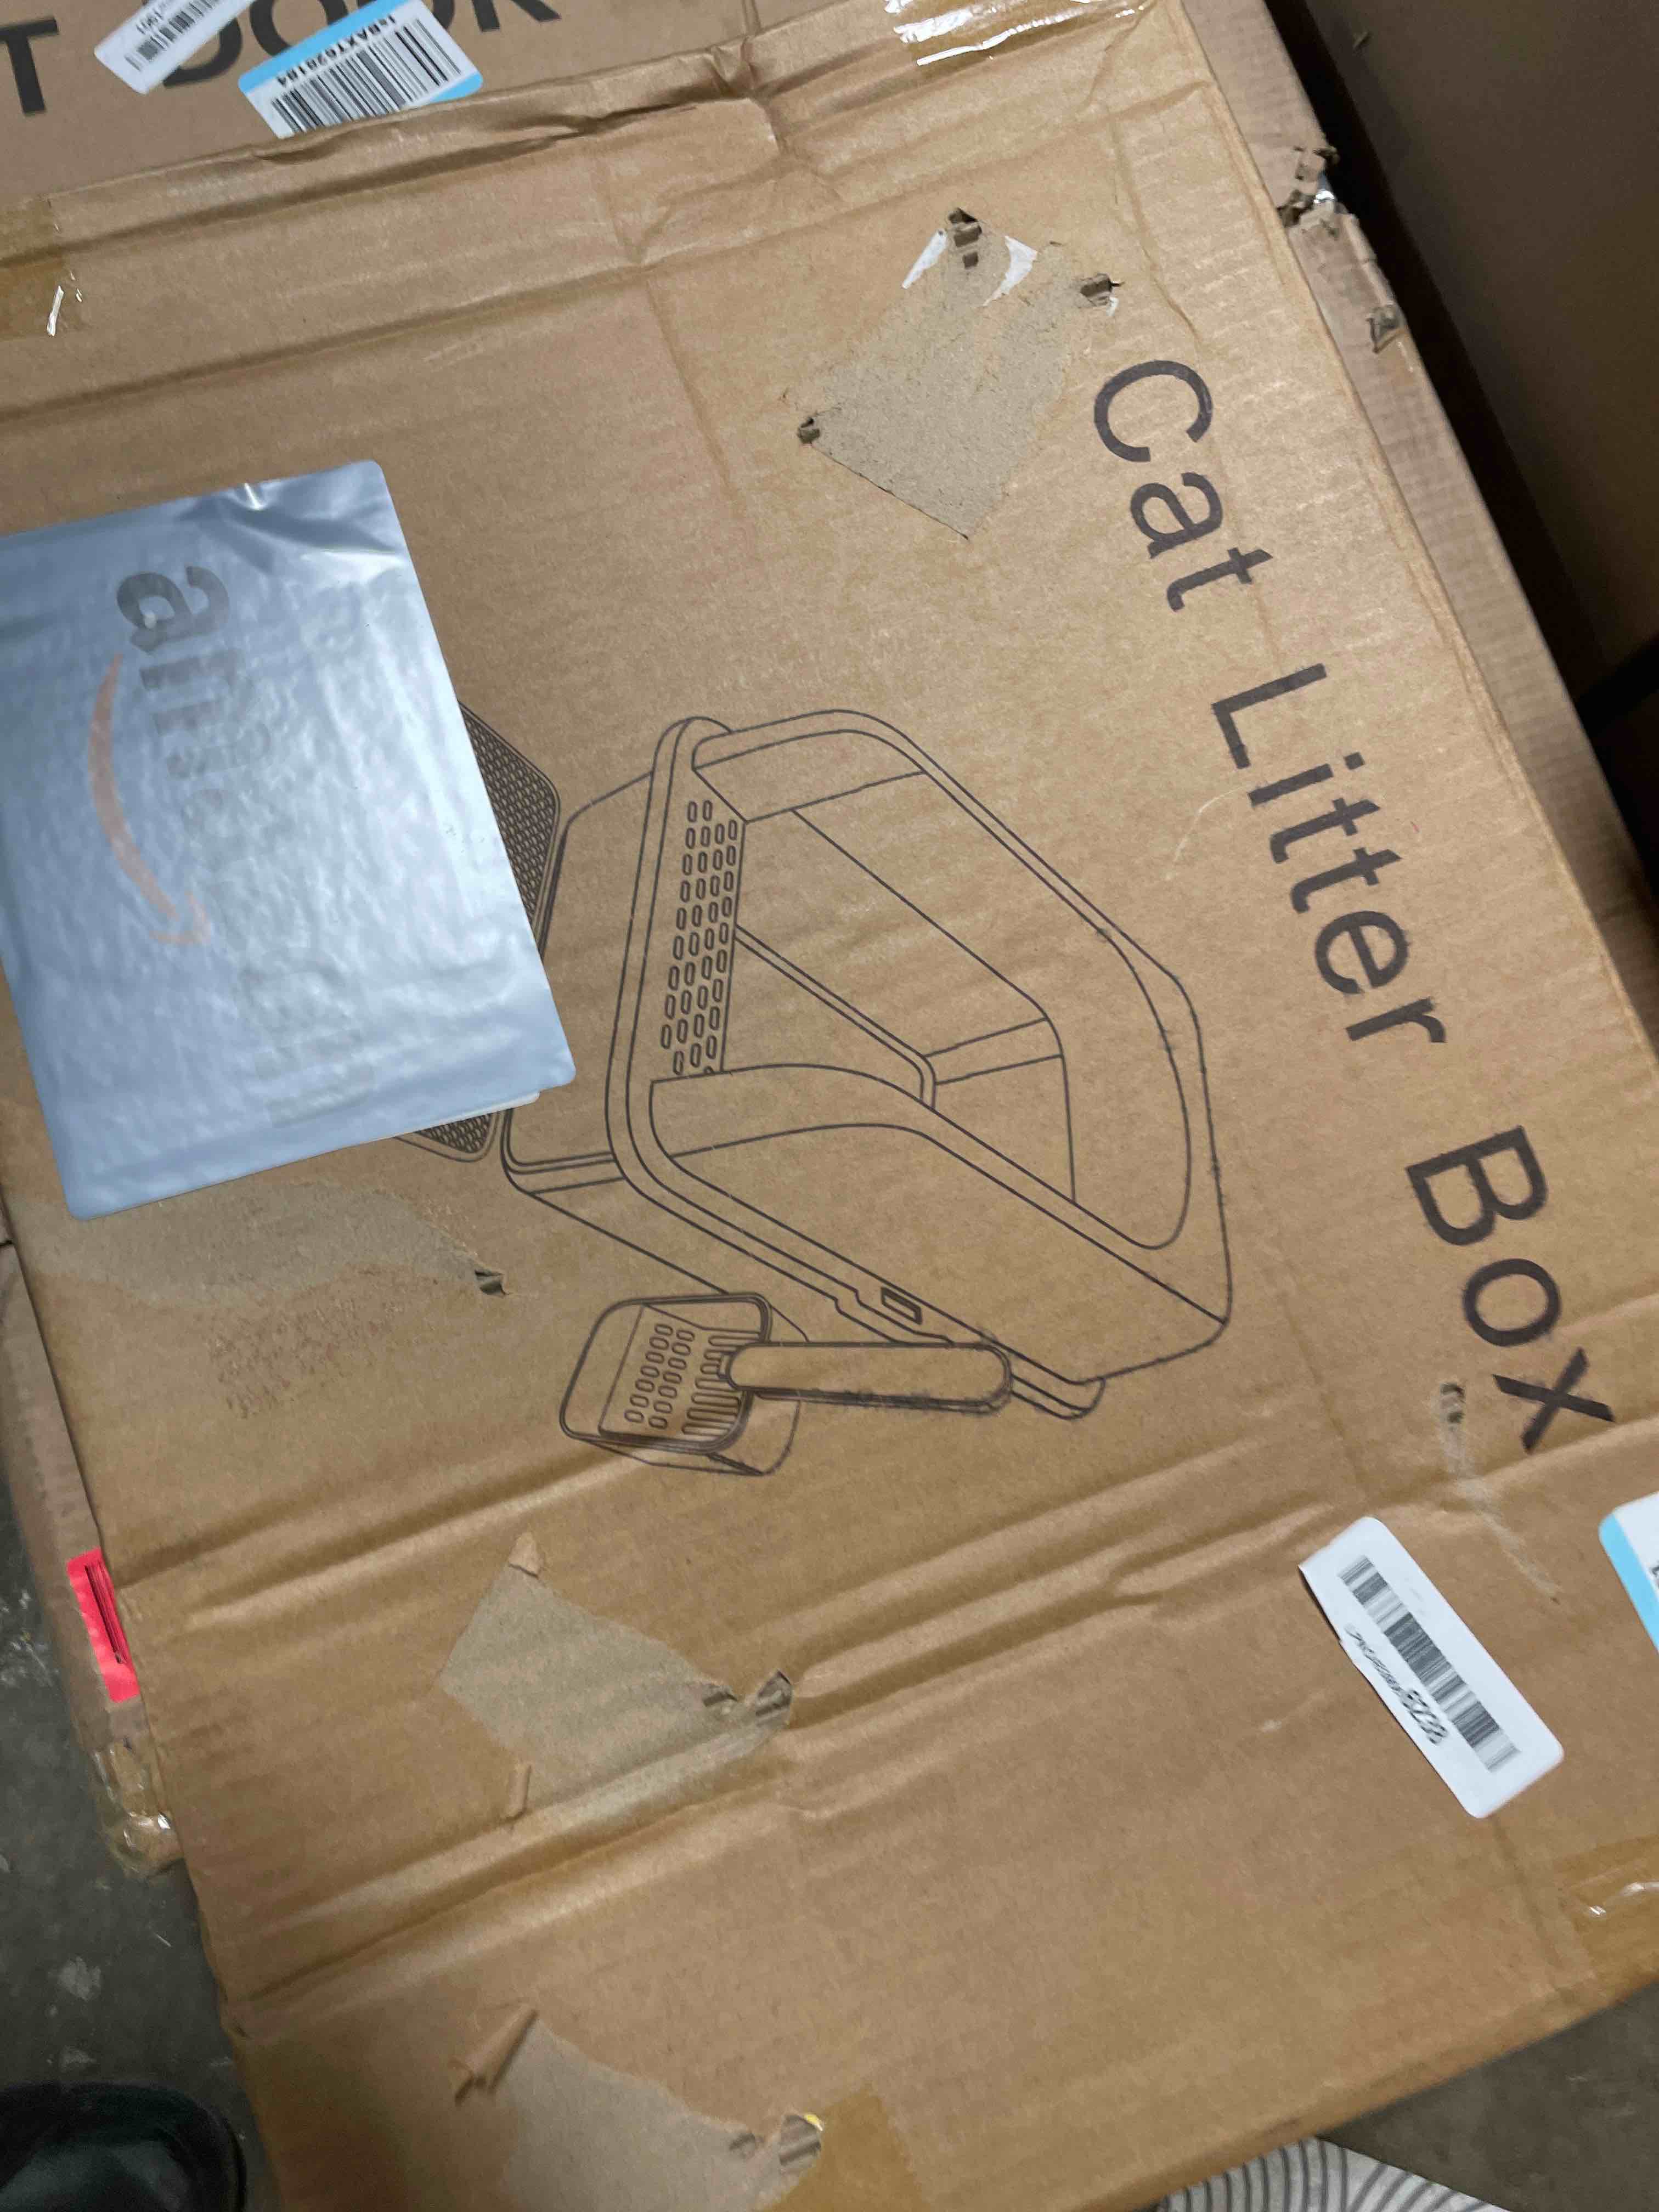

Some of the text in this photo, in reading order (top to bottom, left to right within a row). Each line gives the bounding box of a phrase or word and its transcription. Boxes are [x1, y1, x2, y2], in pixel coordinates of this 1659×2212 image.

[1093, 359, 1616, 1454] Cat Litter Box
